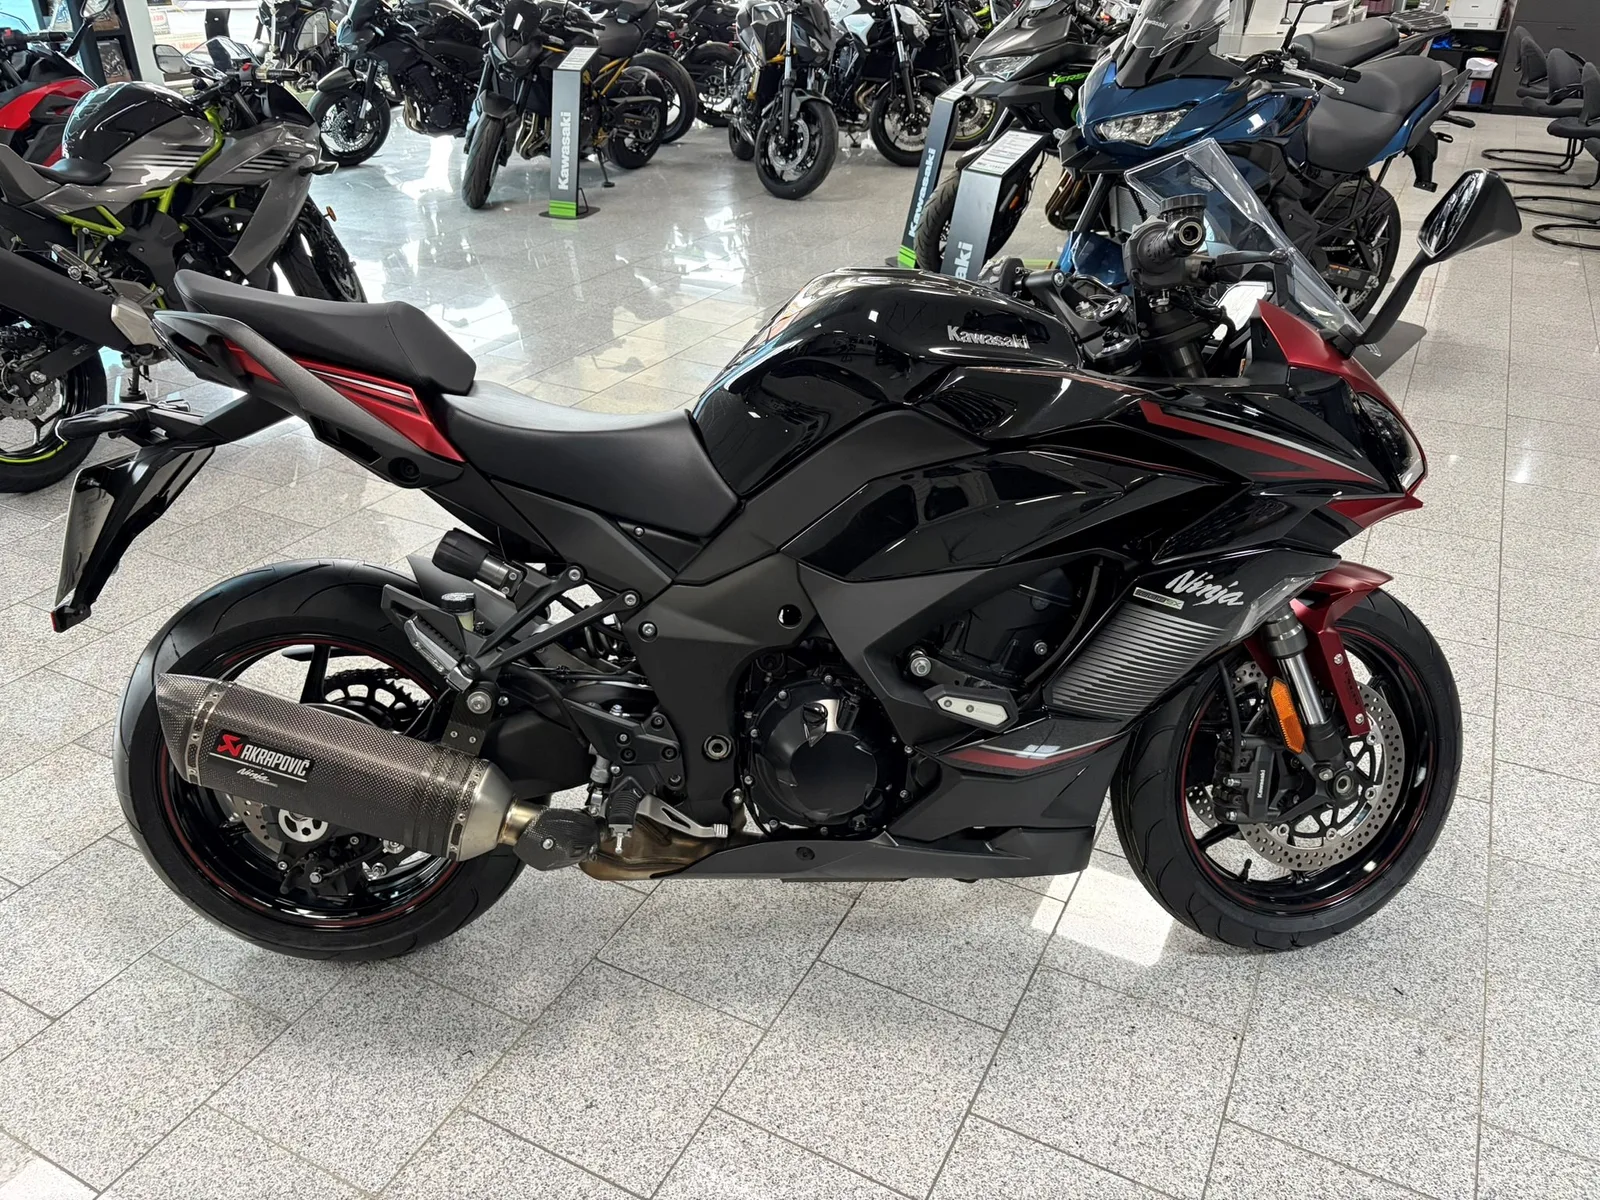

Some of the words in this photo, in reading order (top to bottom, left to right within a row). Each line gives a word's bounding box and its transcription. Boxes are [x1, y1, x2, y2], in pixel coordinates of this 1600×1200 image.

[558, 112, 571, 190] Kawasaki
[908, 148, 936, 237] Kawasaki
[946, 325, 1030, 349] Kawasaki
[1164, 569, 1244, 606] Ninja
[236, 767, 270, 783] Ninja
[1257, 770, 1265, 798] Kawasaki
